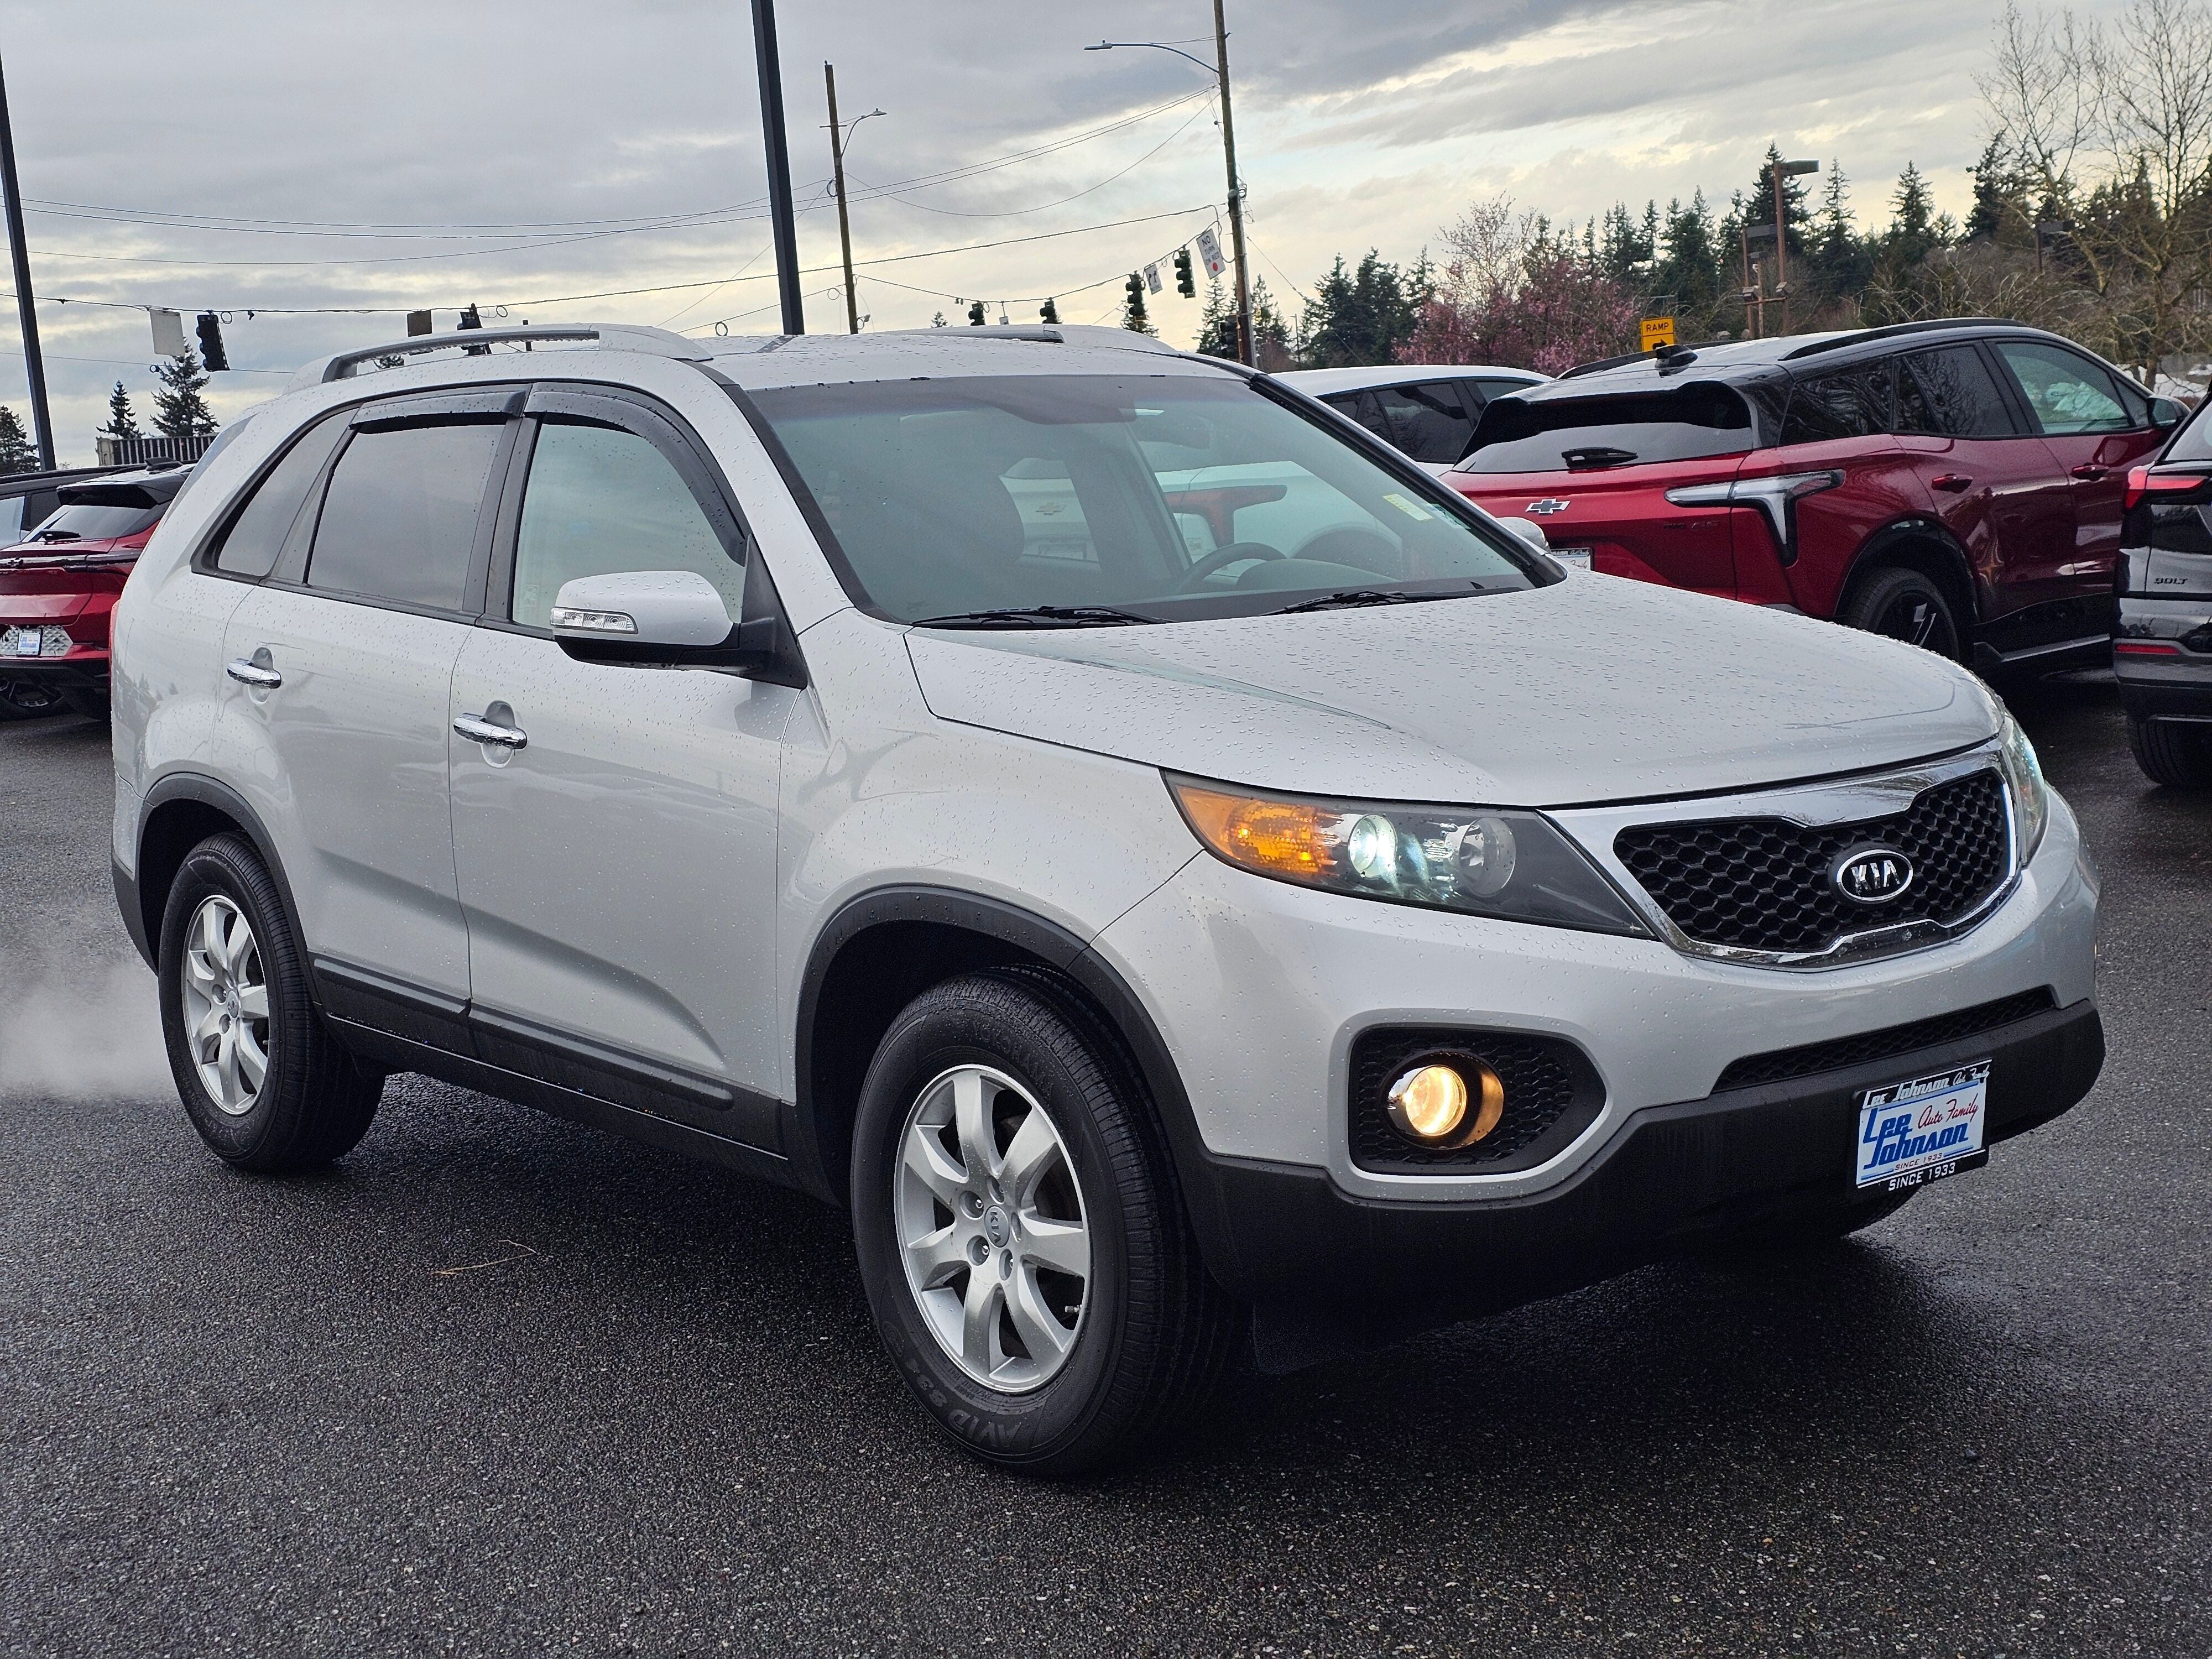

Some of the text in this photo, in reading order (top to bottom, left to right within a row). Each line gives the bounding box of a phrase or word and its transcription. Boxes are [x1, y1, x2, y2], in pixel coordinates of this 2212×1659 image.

[1202, 236, 1211, 247] NO
[1646, 322, 1669, 332] RAMP
[1850, 859, 1901, 895] KIA
[1892, 1078, 1950, 1101] Johnson
[1863, 1107, 1913, 1144] Lee
[1918, 1093, 1979, 1129] Auto Family
[1863, 1123, 1969, 1170] Johnson
[1895, 1152, 1943, 1171] SINCE 1933
[1888, 1162, 1956, 1191] SINCE 1933
[990, 1211, 1001, 1244] KIA
[948, 1408, 1022, 1448] AVID
